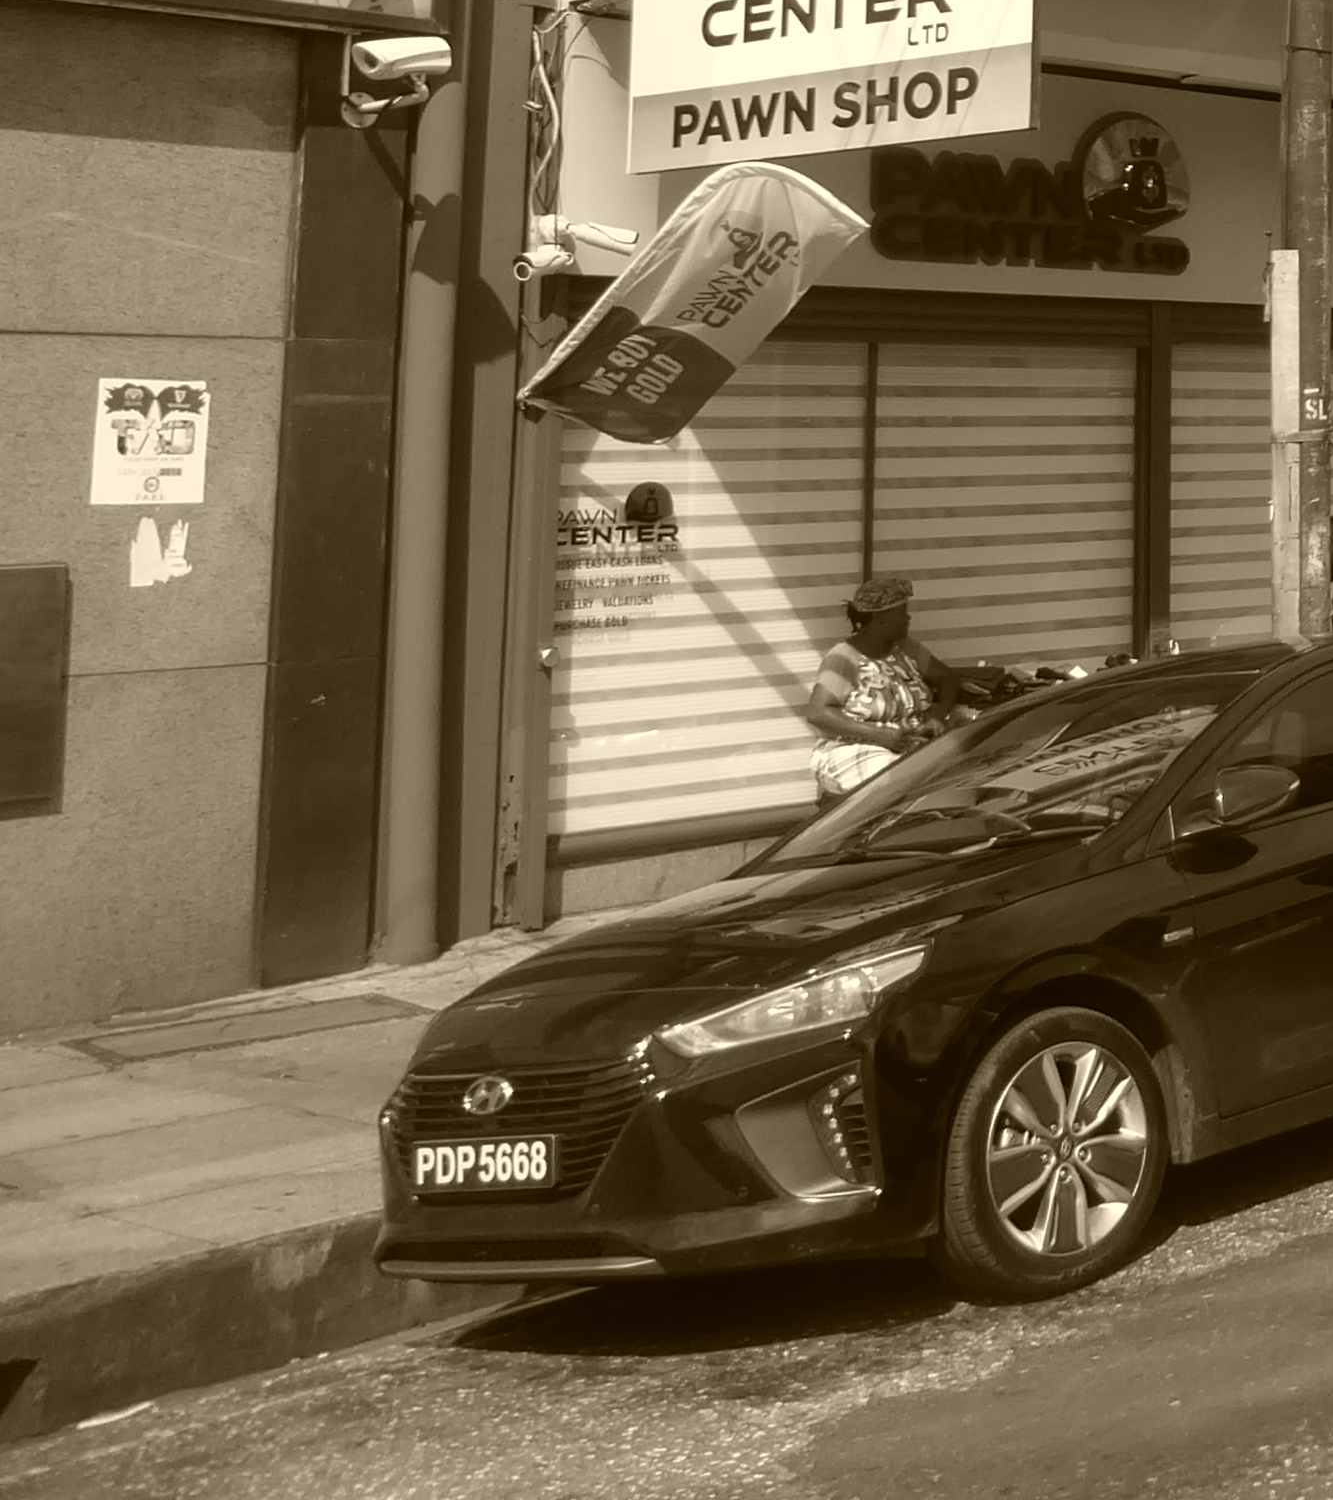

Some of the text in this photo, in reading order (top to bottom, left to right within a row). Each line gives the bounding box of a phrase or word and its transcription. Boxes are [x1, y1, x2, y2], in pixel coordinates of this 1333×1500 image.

[906, 22, 950, 46] LTD
[671, 66, 980, 149] PAWN SHOP
[870, 213, 1124, 272] CENTER
[676, 268, 737, 322] PAWN
[701, 230, 799, 329] CENTER
[579, 333, 658, 396] WE BUY
[625, 353, 685, 405] GOLD
[1305, 399, 1327, 420] SL
[658, 544, 679, 553] LTD
[417, 1140, 548, 1186] PDP 5668
